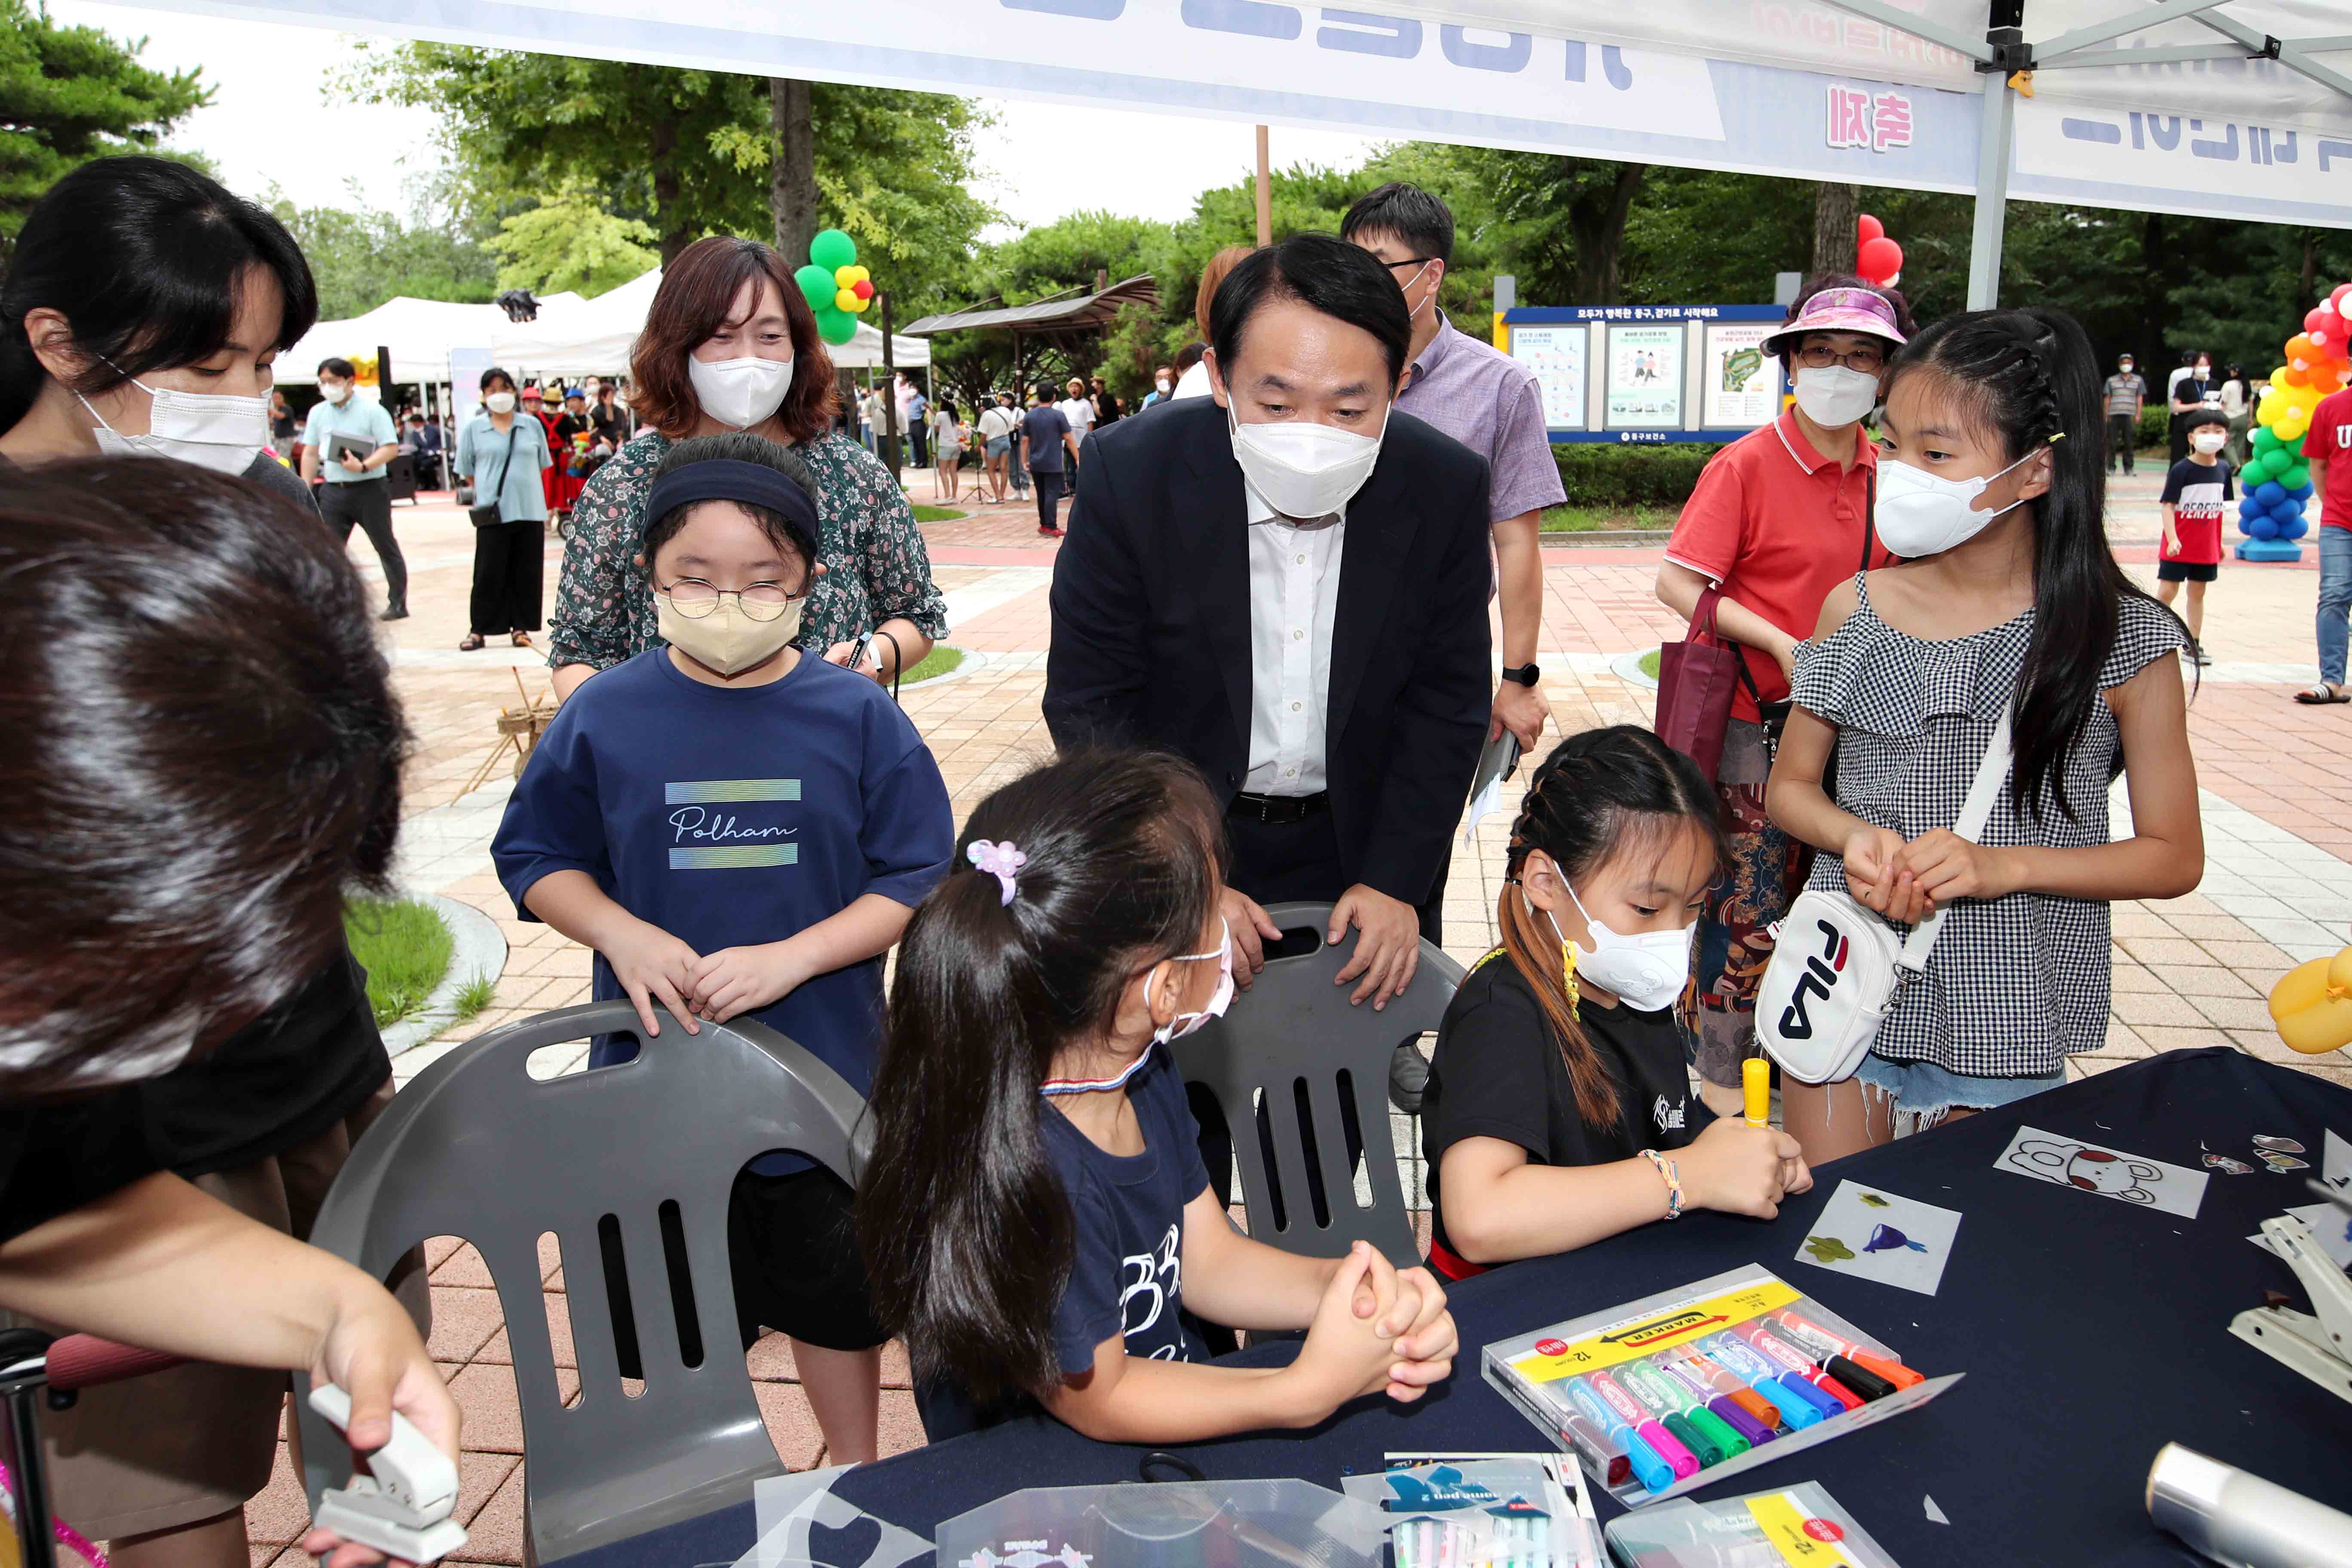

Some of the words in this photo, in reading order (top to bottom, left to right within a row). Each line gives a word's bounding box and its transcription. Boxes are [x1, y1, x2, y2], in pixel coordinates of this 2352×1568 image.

[1577, 309, 1603, 318] 모두가
[1606, 308, 1632, 319] 행복한
[1684, 308, 1719, 318] 시작해요
[668, 806, 798, 843] Polham
[1778, 919, 1849, 1040] FILA
[1632, 1315, 1697, 1342] MARKER
[1573, 1351, 1592, 1362] 12
[1434, 1491, 1460, 1500] pen
